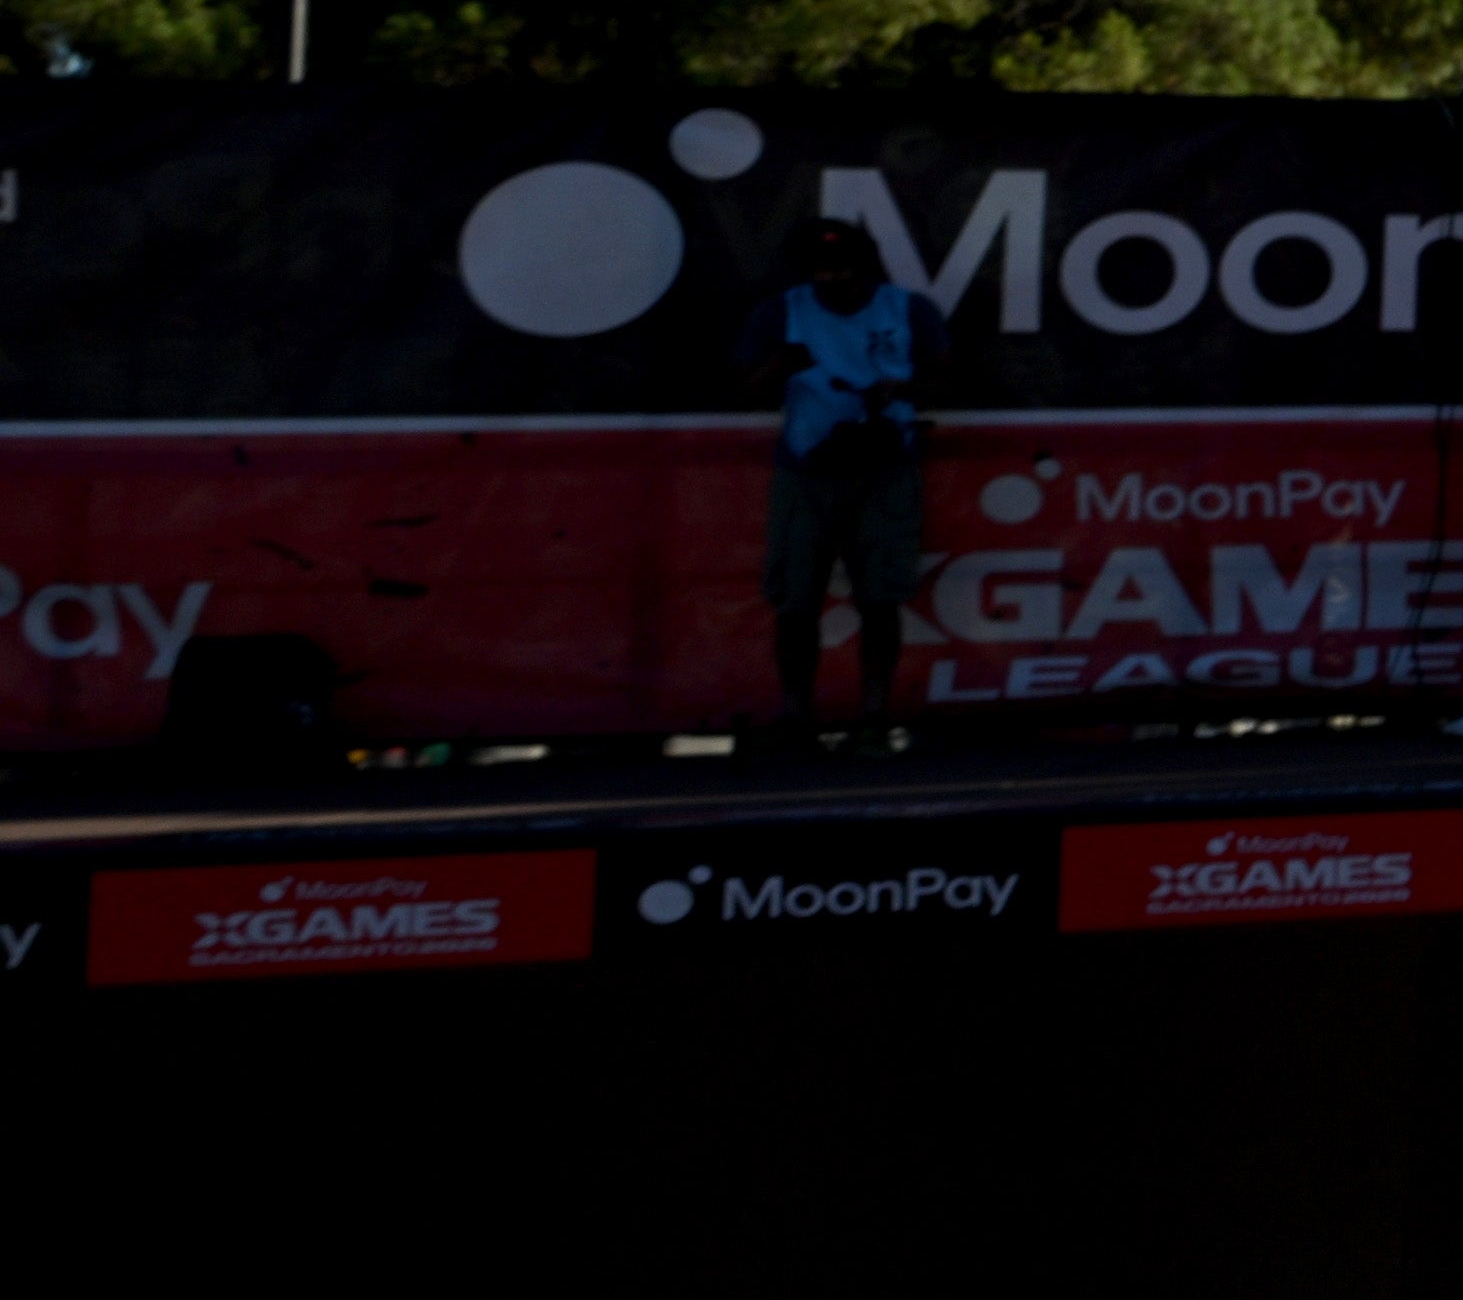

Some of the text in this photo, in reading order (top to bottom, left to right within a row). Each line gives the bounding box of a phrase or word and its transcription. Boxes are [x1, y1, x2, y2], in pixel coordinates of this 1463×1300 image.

[1074, 470, 1408, 528] MoonPay
[924, 642, 1463, 704] LEAGUE
[720, 868, 1021, 923] MoonPay
